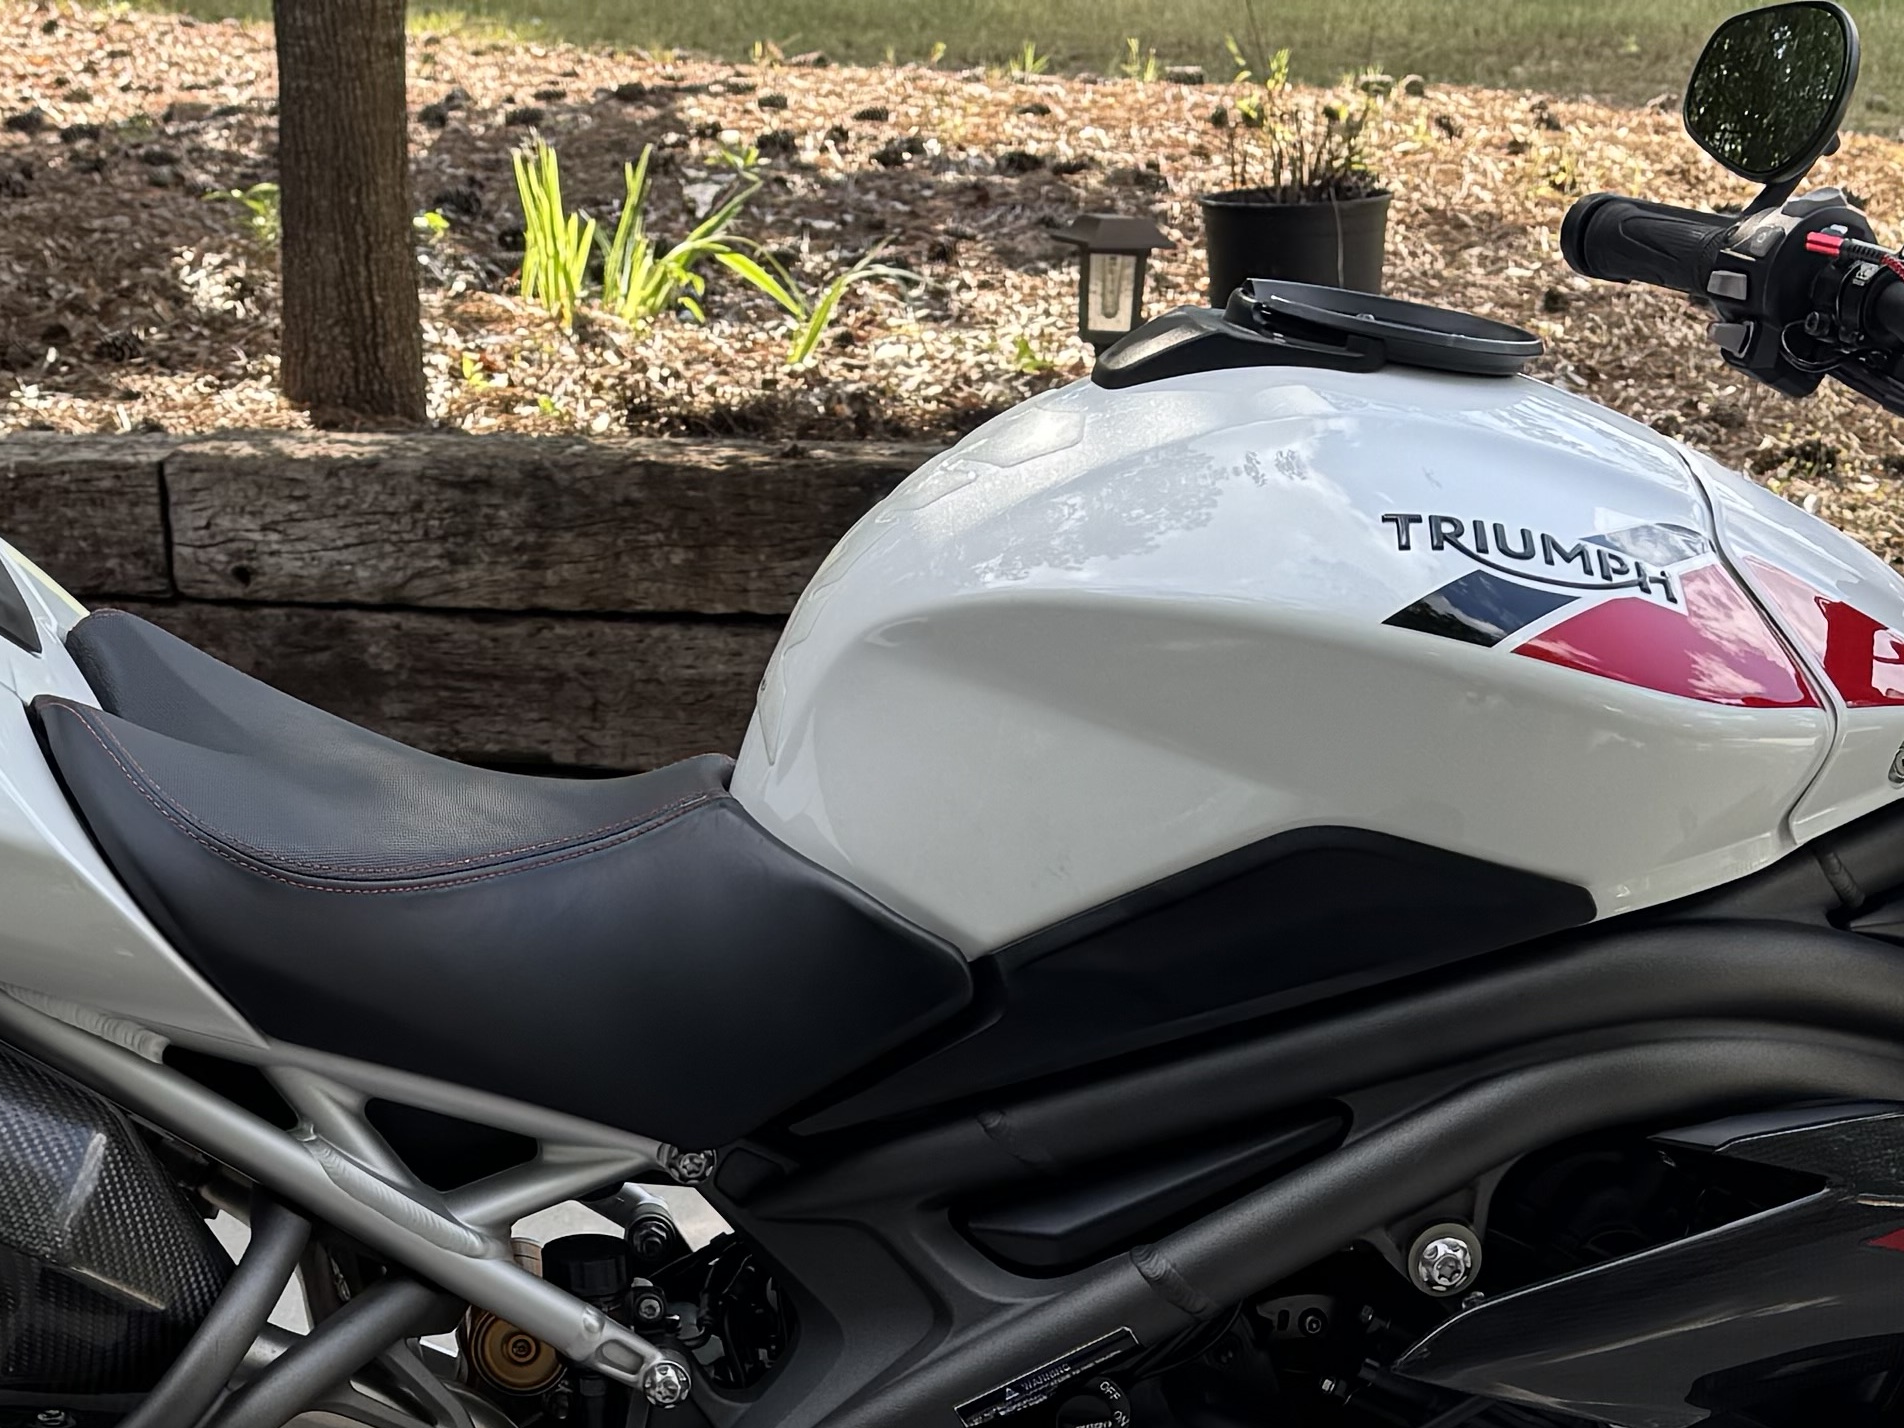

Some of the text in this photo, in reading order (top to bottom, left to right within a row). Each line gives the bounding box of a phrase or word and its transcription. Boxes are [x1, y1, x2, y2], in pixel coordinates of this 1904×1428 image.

[1382, 513, 1678, 604] TRIUMPH
[1099, 1380, 1121, 1401] OFF
[1113, 1410, 1130, 1428] ON
